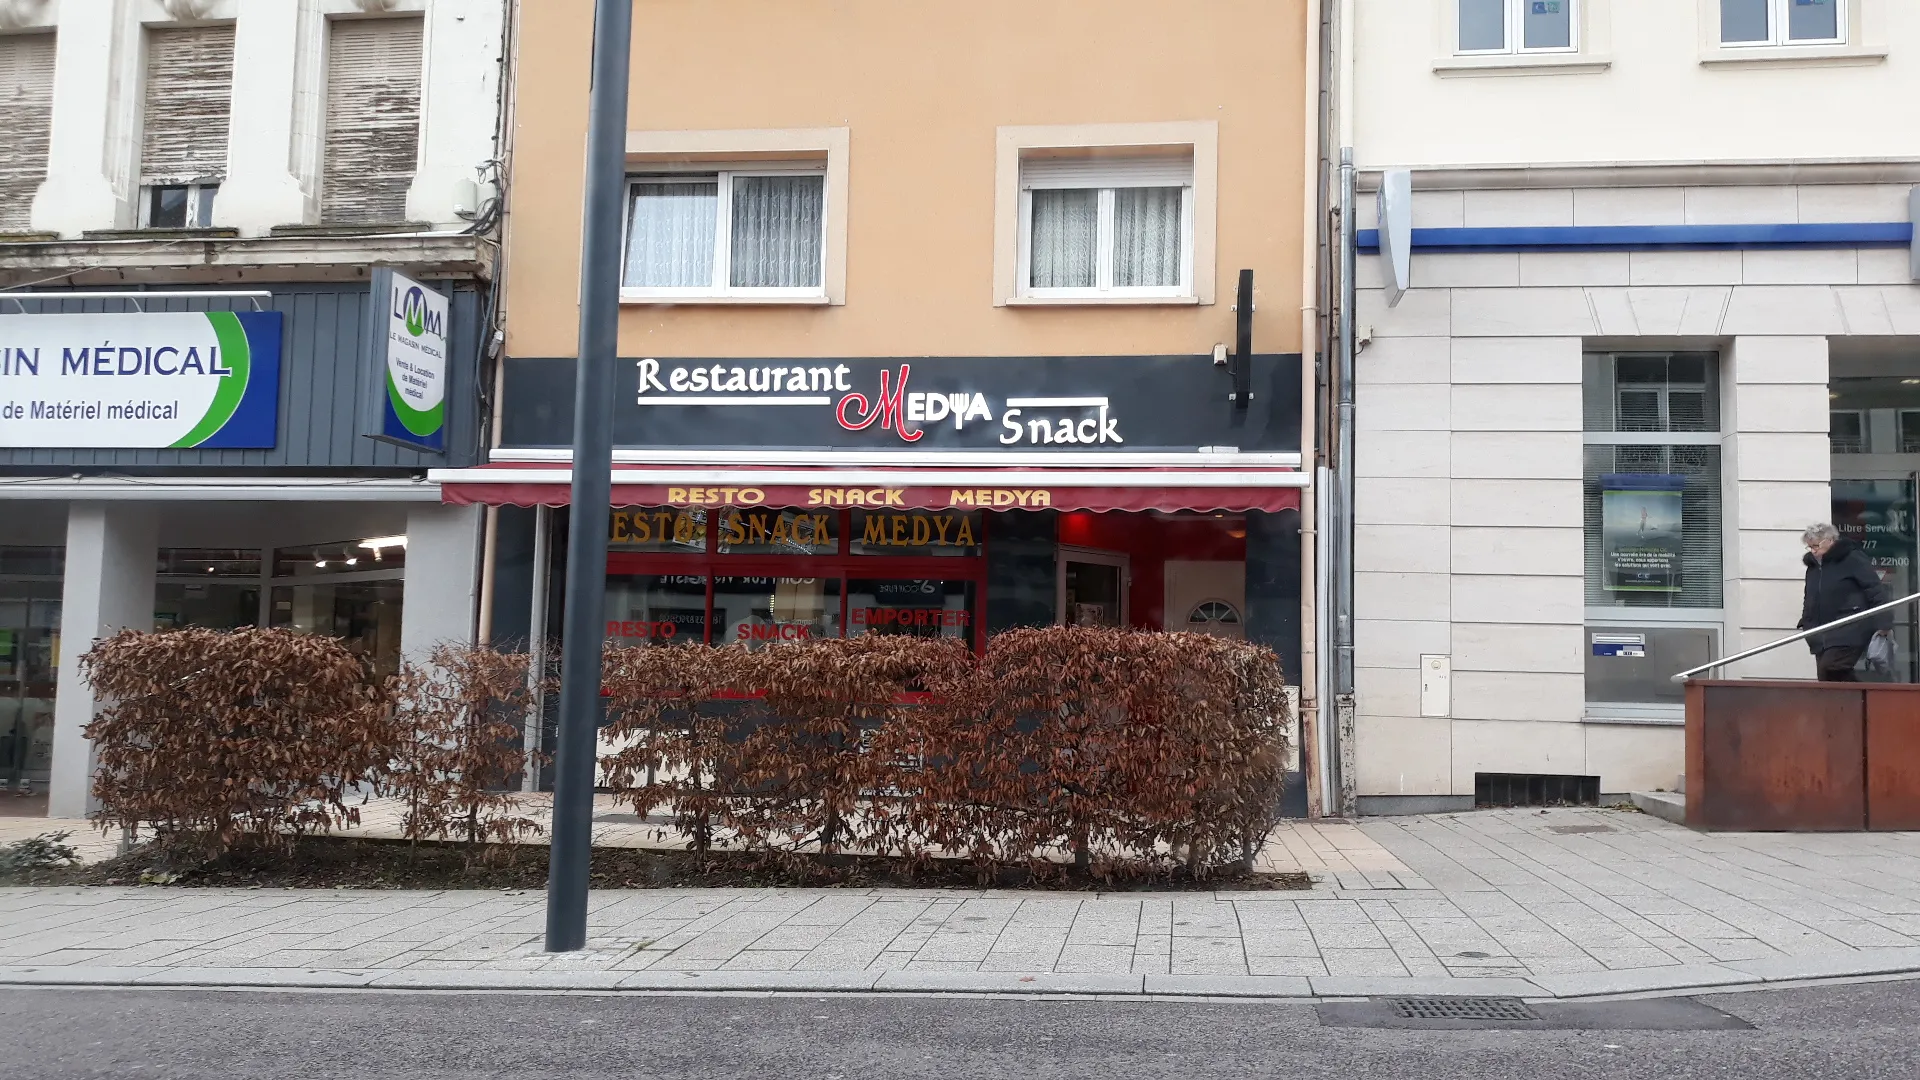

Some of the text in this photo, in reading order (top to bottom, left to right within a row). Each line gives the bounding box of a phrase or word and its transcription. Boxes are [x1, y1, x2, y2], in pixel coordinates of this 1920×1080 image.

[398, 334, 419, 350] MAGASIN
[61, 341, 232, 376] MÉDICAL
[396, 357, 435, 379] Vente & Location
[637, 358, 852, 394] Restaurant
[402, 373, 427, 389] de Matériel
[3, 400, 178, 419] de Matériel médical
[1000, 405, 1123, 445] Snack
[668, 488, 1051, 506] RESTO SNACK MEDYA
[611, 512, 975, 546] ESTO SNACK MEDYA
[1839, 524, 1862, 532] Libre
[1862, 541, 1877, 549] 7/7
[1881, 557, 1909, 566] 22h00
[852, 608, 970, 626] EMPORTER
[606, 621, 676, 638] RESTO
[737, 624, 811, 641] SNACK
